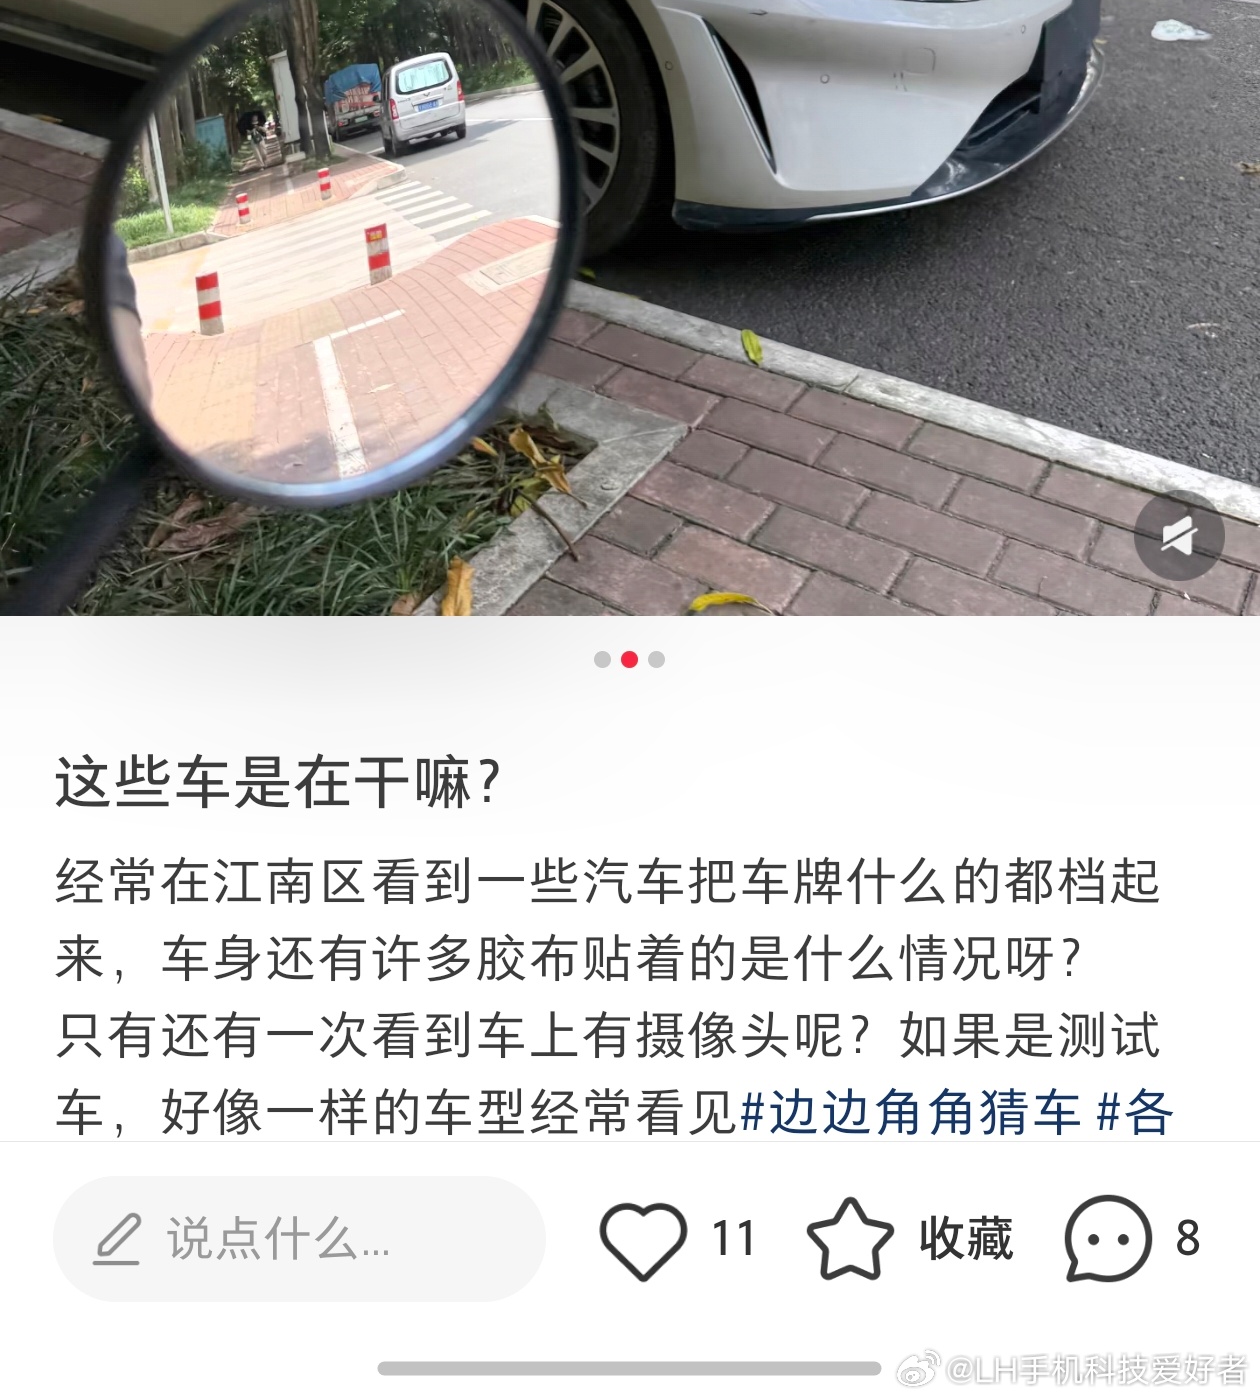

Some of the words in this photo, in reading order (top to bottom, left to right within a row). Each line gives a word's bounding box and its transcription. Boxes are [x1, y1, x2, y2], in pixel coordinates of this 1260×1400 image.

[55, 856, 1160, 905] 经常在江南区看到一些汽车把车牌什么的都档起
[1096, 1087, 1174, 1136] #各
[713, 1219, 752, 1256] 11
[919, 1214, 1014, 1261] 收藏
[1176, 1218, 1200, 1257] 8
